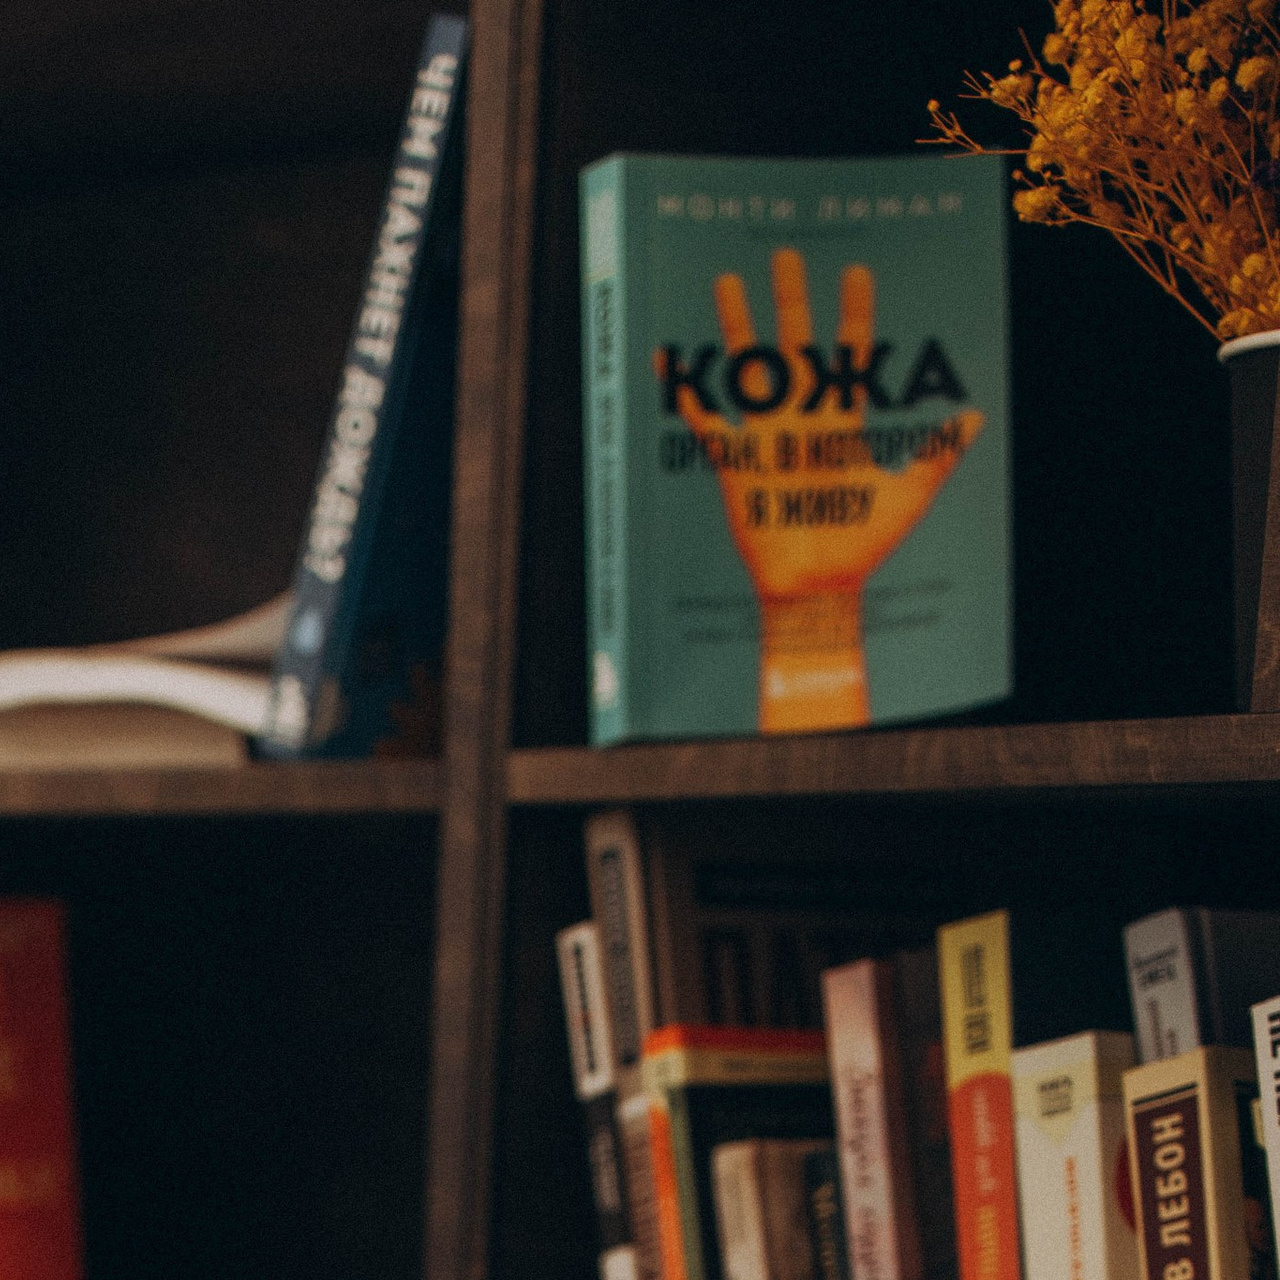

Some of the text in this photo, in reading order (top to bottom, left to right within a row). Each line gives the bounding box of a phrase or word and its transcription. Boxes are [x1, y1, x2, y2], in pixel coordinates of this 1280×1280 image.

[303, 53, 458, 584] ЧЕМ ПАХНЕТ ДОЖДЬ?
[660, 338, 970, 416] КОЖА
[1150, 1110, 1195, 1247] ЛЕБОН
